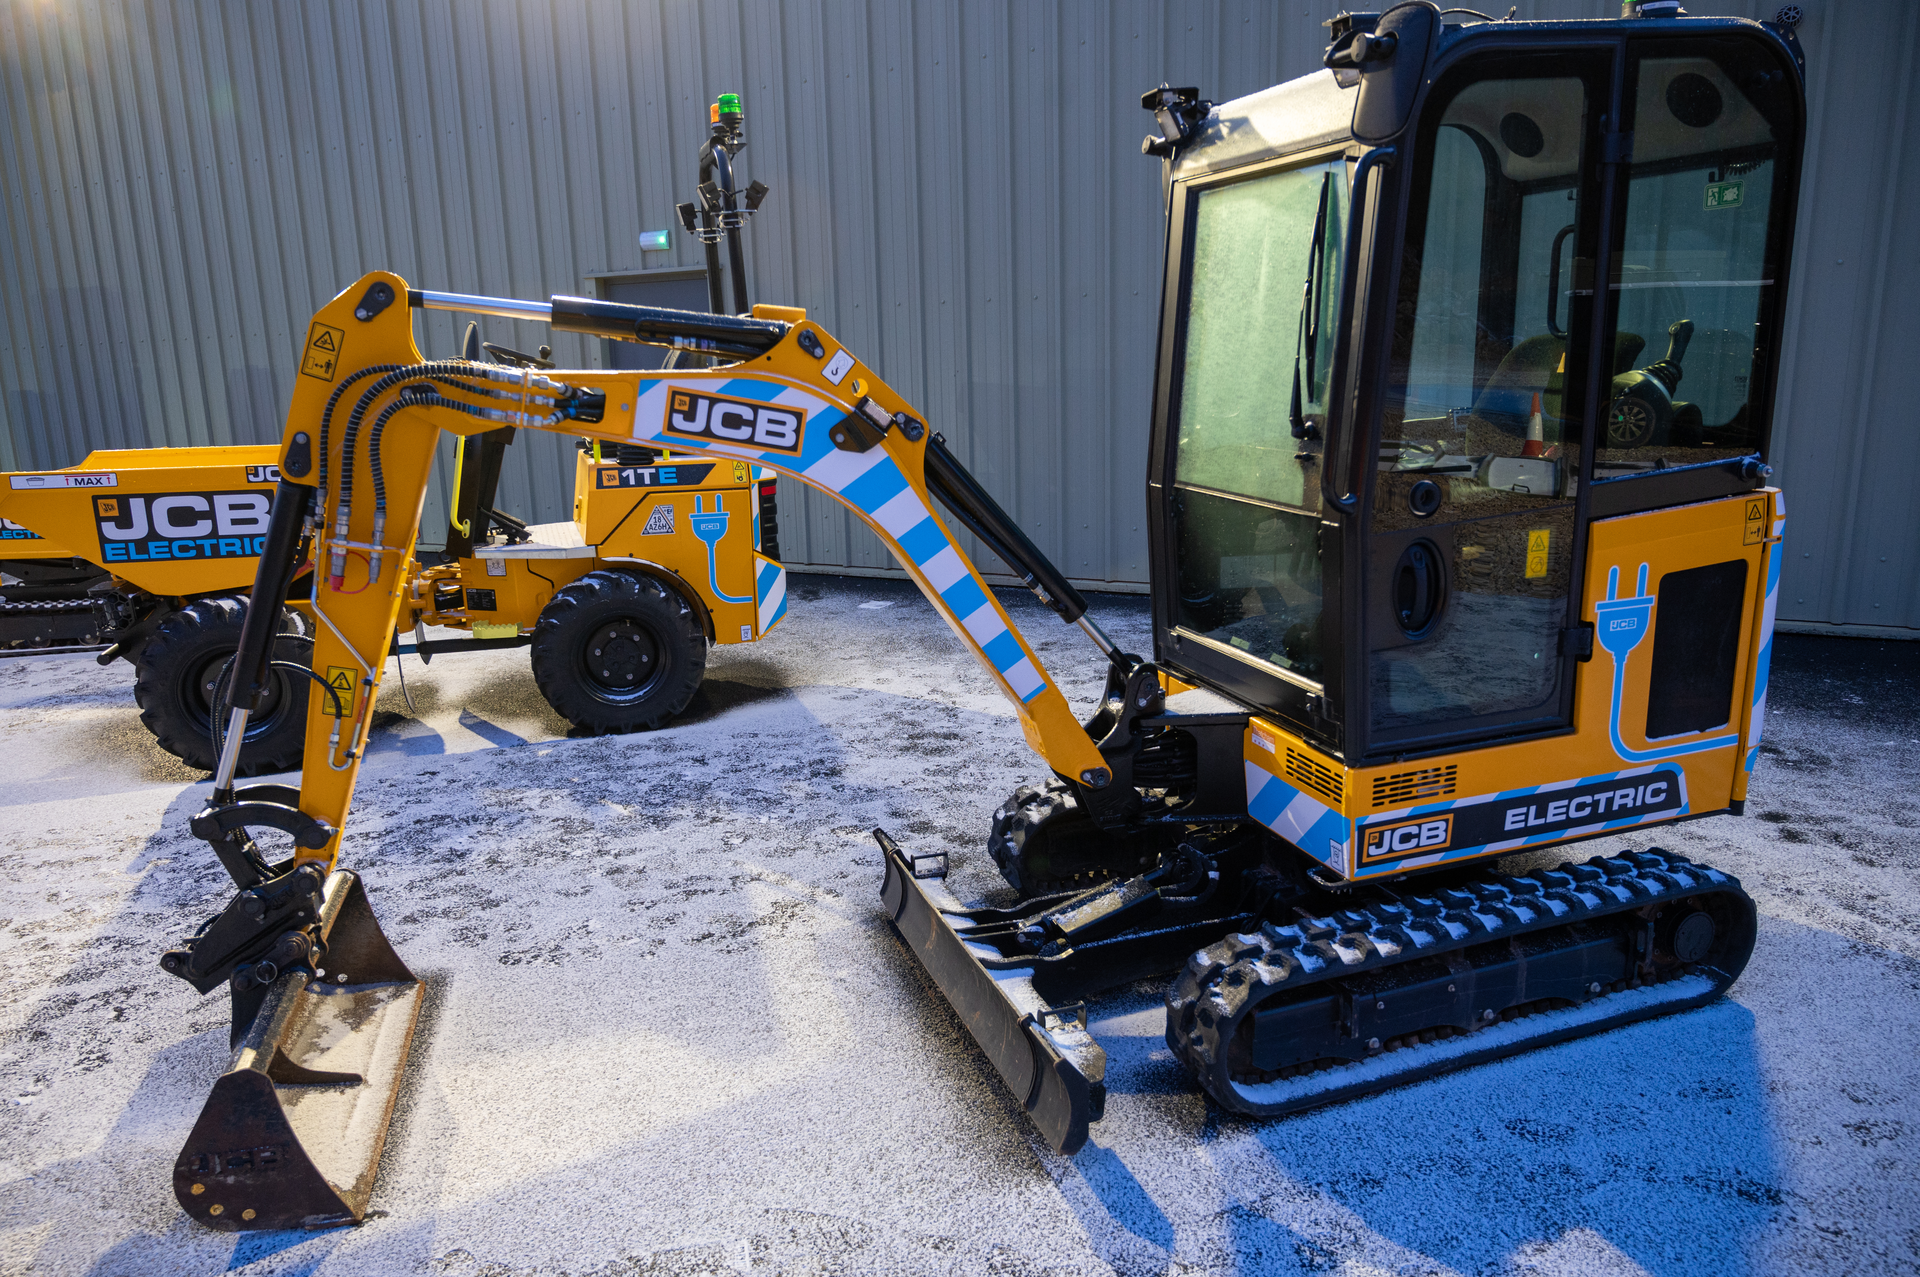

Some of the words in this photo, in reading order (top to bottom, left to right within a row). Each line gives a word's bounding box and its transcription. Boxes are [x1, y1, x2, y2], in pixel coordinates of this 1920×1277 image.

[671, 398, 798, 447] JCB
[74, 477, 104, 486] MAX
[247, 466, 282, 482] JC
[621, 467, 678, 485] 1TE
[101, 493, 272, 541] JCB
[653, 515, 662, 524] 18
[0, 530, 40, 539] ECT
[1611, 619, 1636, 630] JCB
[1367, 820, 1447, 856] JCB
[1503, 781, 1668, 831] ELECTRIC
